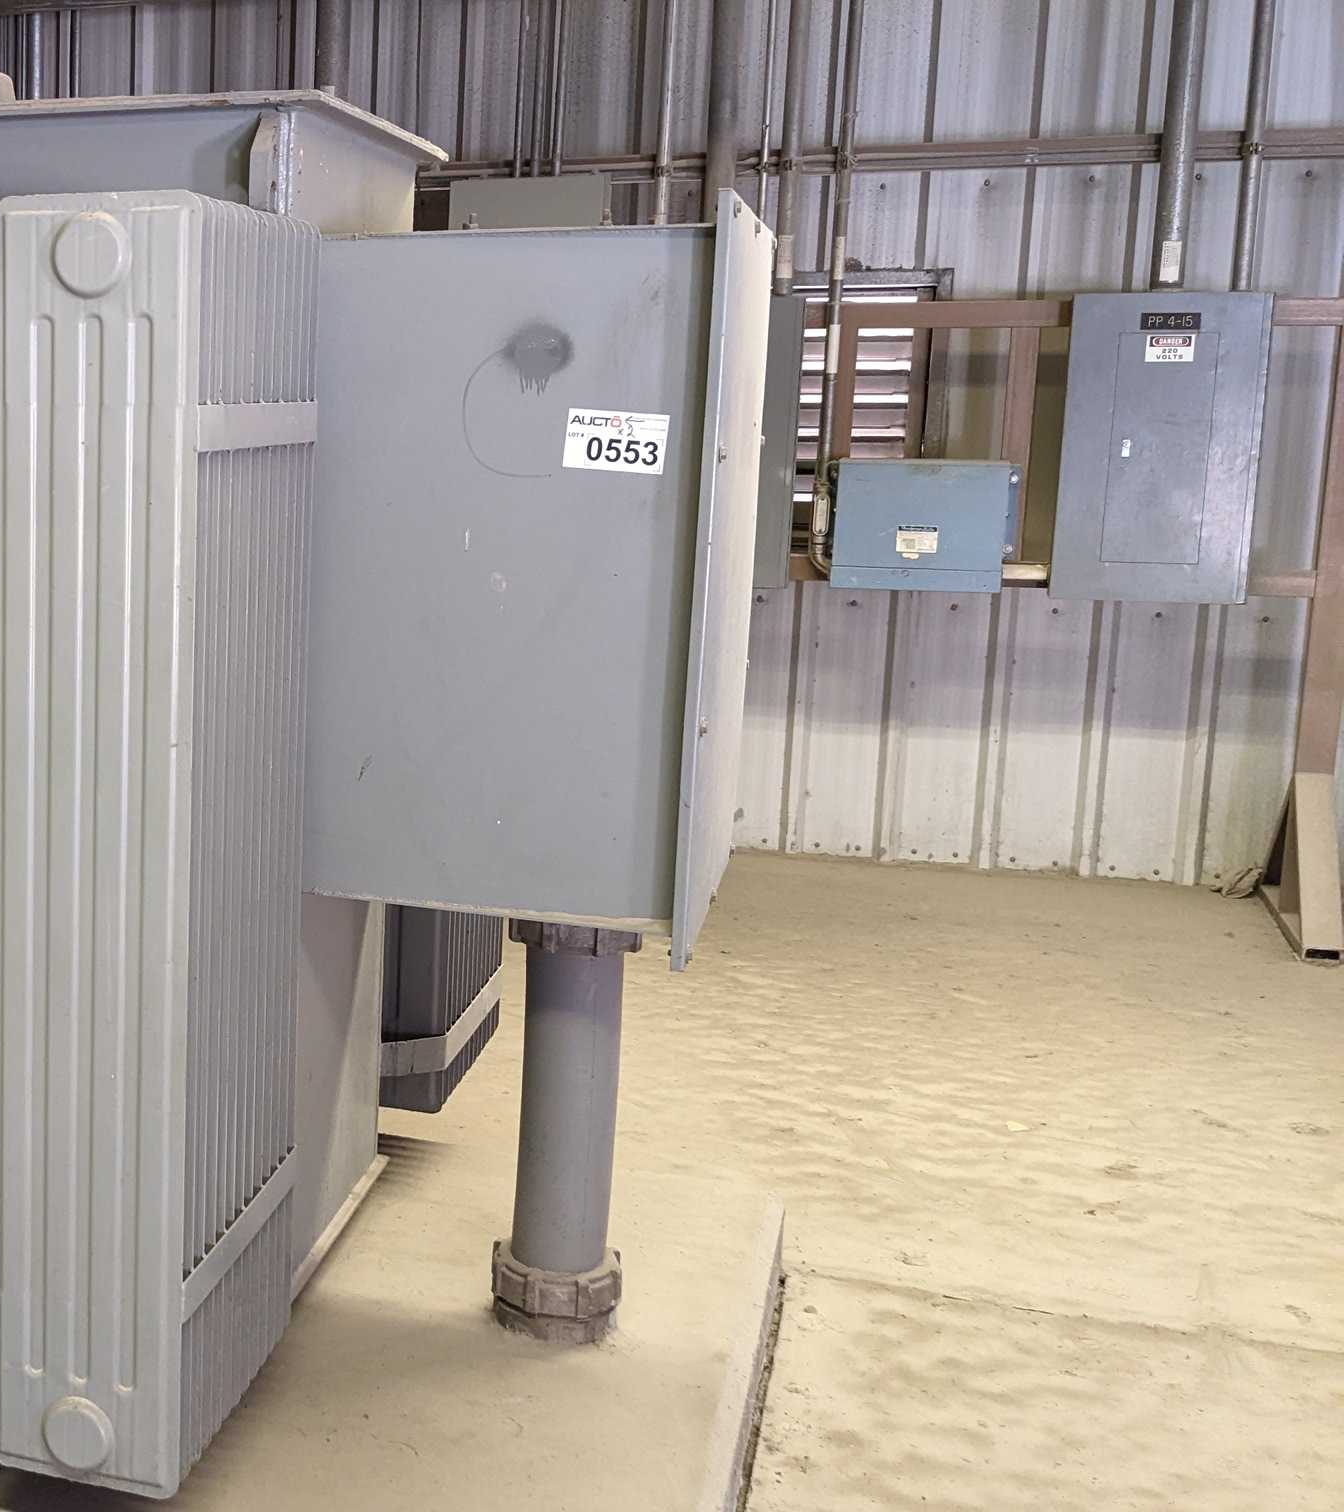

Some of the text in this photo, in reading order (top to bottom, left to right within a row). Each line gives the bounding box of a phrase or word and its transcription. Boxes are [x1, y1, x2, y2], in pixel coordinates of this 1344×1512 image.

[1148, 315, 1193, 327] PP 4-15
[586, 437, 658, 465] 0553
